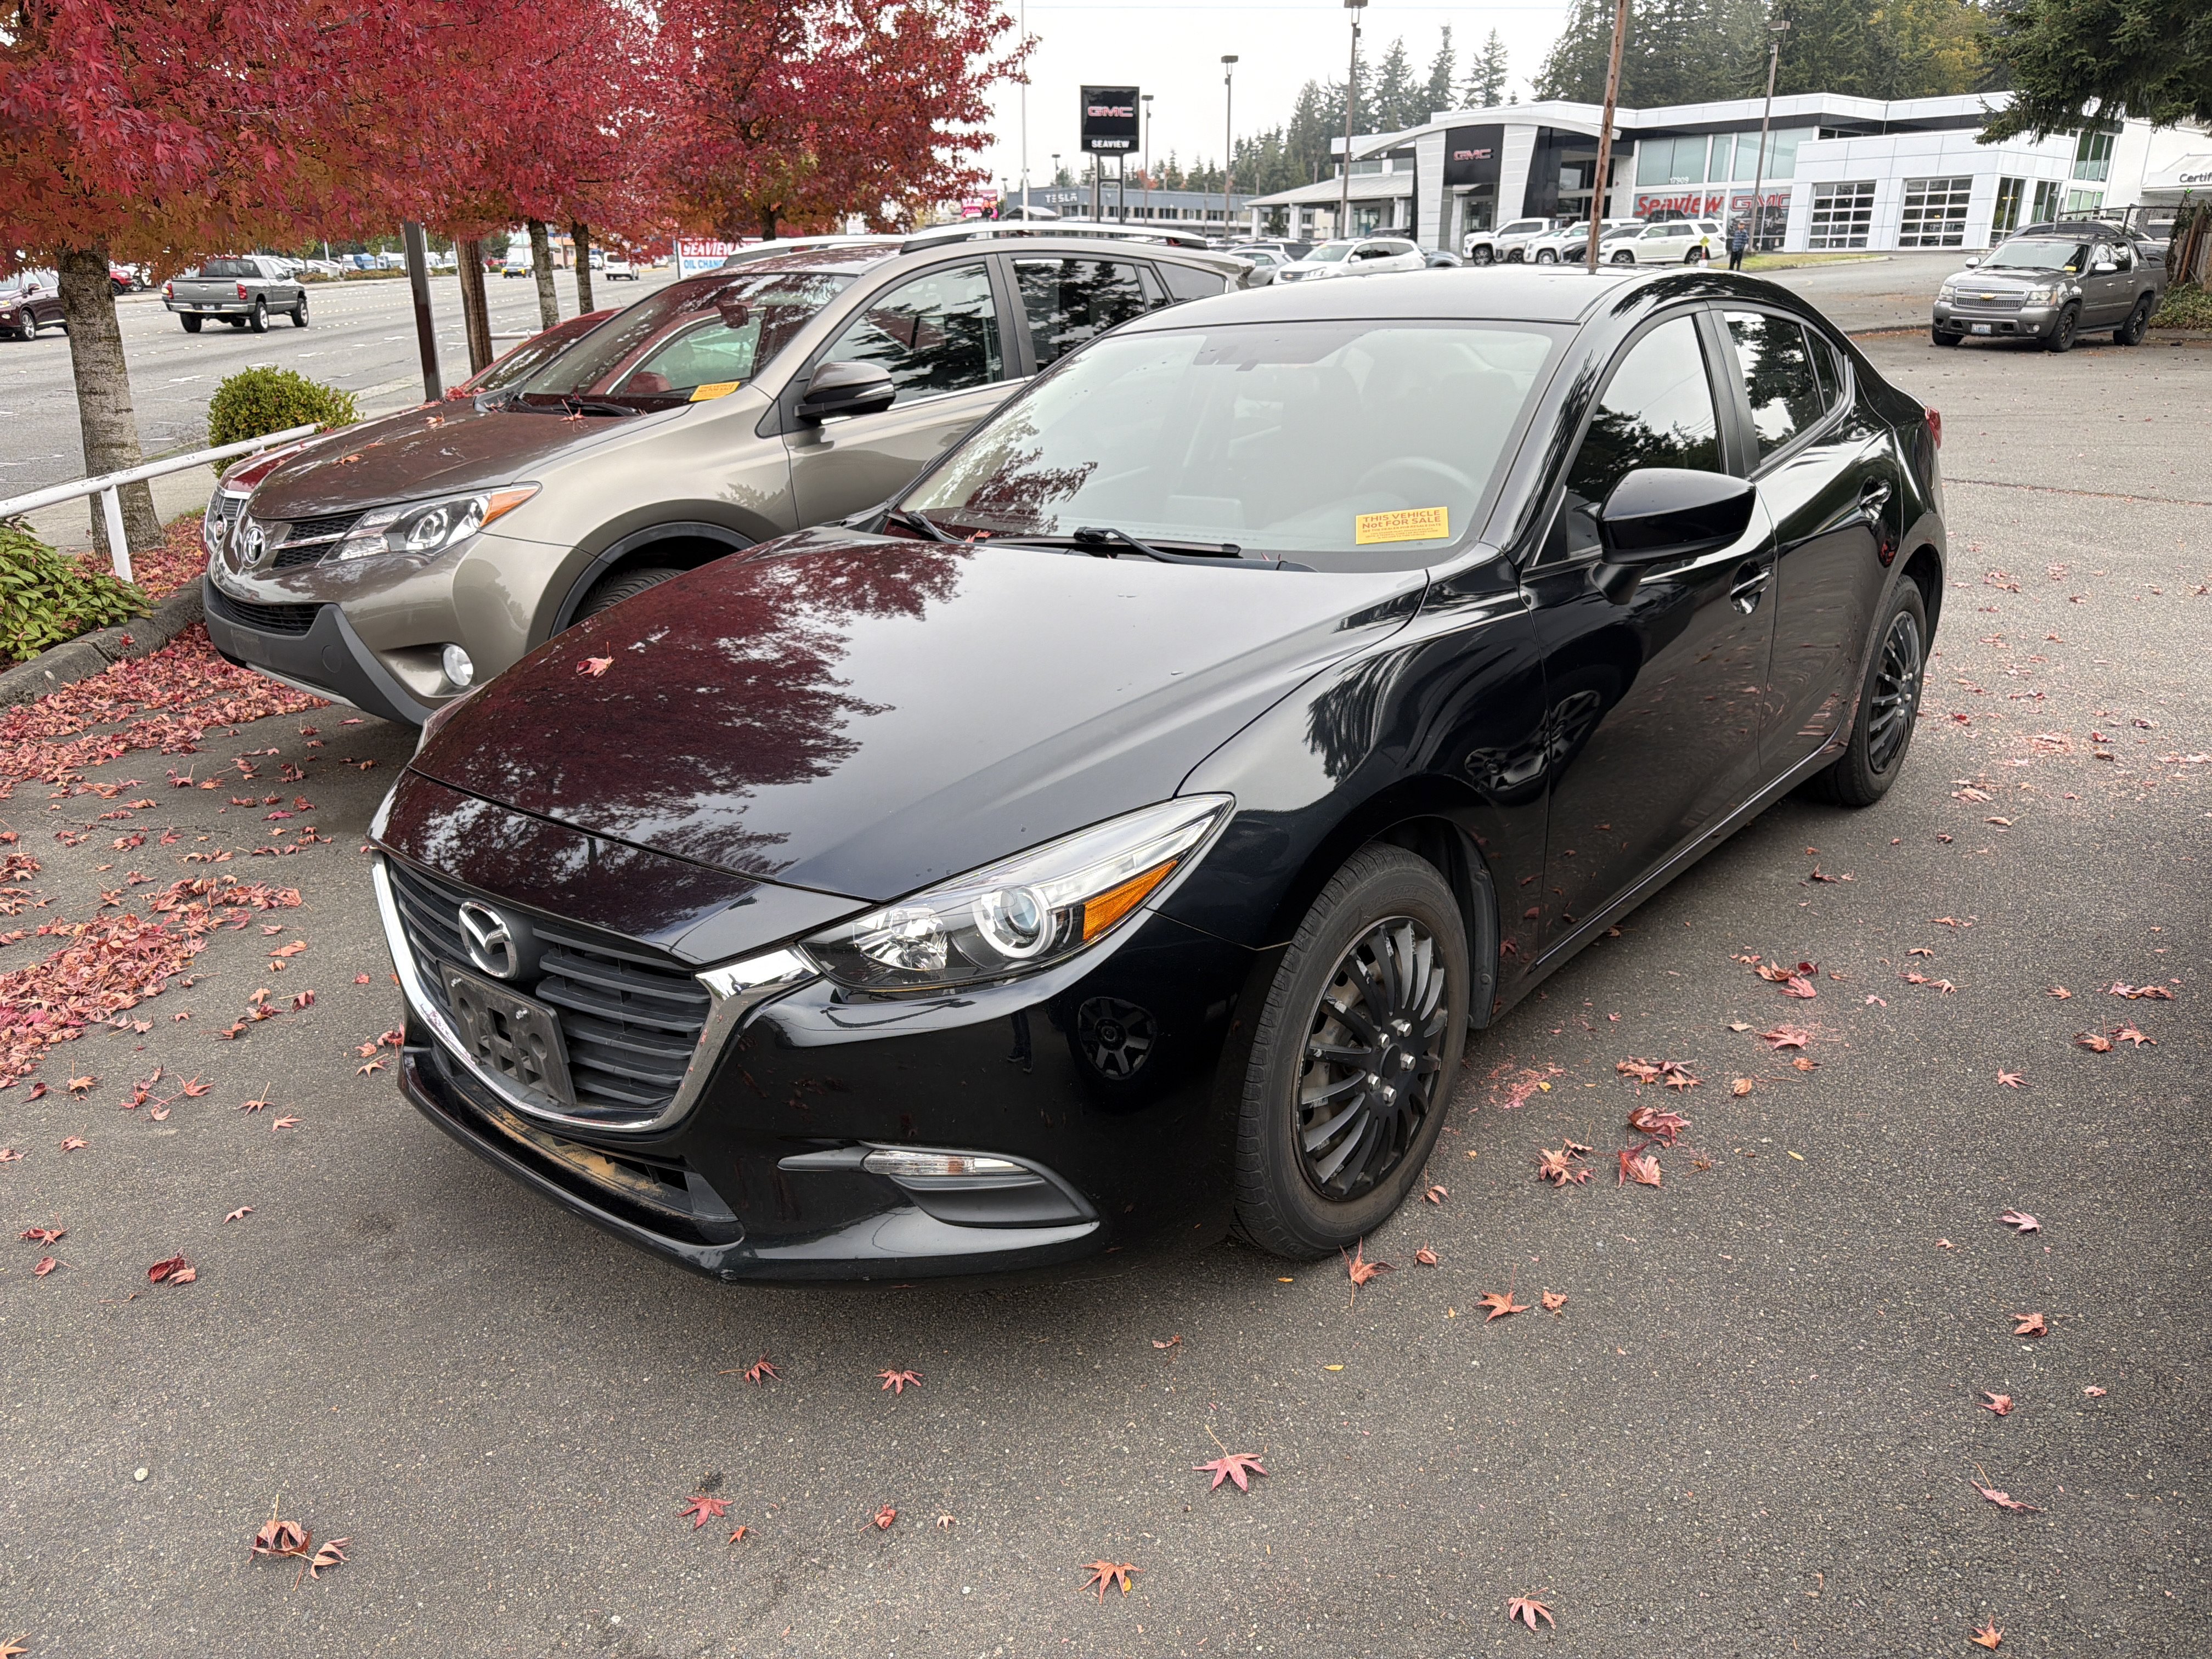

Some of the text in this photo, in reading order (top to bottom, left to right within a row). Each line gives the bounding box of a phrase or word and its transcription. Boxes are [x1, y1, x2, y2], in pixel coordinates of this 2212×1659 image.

[1088, 106, 1134, 117] GMC
[1091, 140, 1130, 148] SEAVIEW
[1453, 148, 1492, 161] GMC
[1045, 193, 1077, 204] TESLA
[1634, 193, 1792, 216] Seaview GMC
[684, 259, 697, 269] OIL
[1392, 510, 1440, 520] VEHICLE
[1412, 516, 1441, 524] SALE
